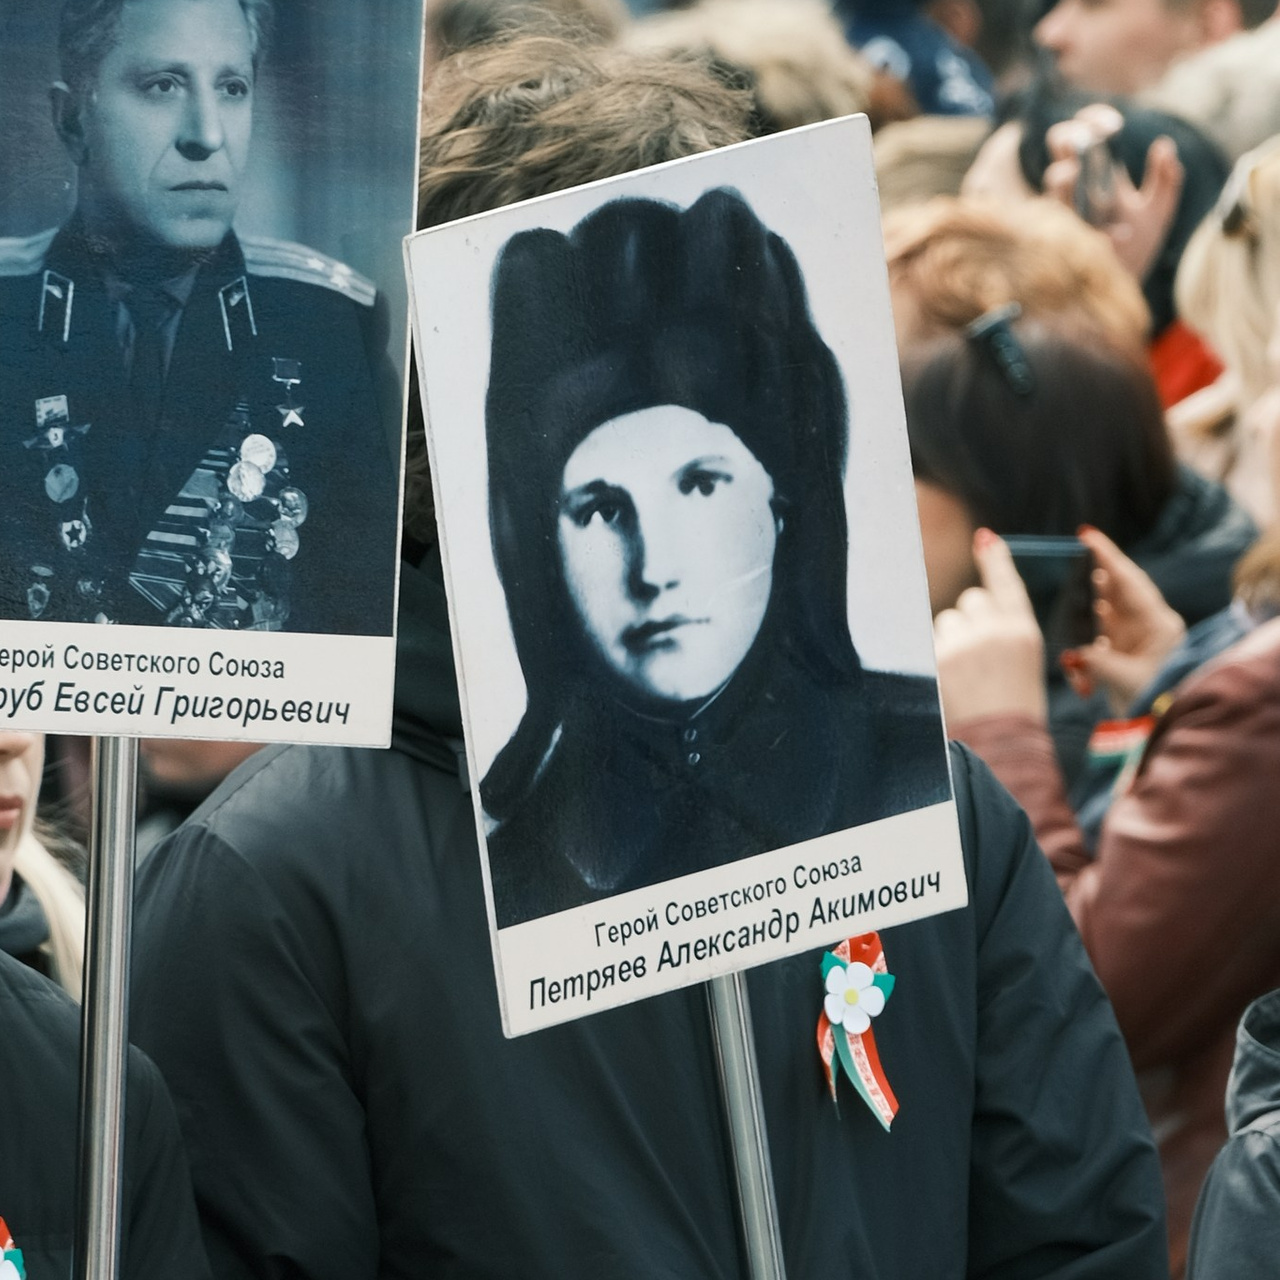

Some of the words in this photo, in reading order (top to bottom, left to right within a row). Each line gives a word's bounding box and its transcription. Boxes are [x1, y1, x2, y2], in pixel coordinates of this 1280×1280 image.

[63, 644, 201, 677] Советского
[208, 651, 286, 680] Союза
[53, 681, 145, 717] Евсей
[153, 685, 351, 727] Григорьевич
[594, 906, 660, 948] Герой
[664, 874, 787, 927] Советского
[793, 854, 863, 891] Союза
[528, 954, 648, 1011] Петряев
[656, 906, 801, 974] Александр
[808, 870, 943, 930] Акимович
